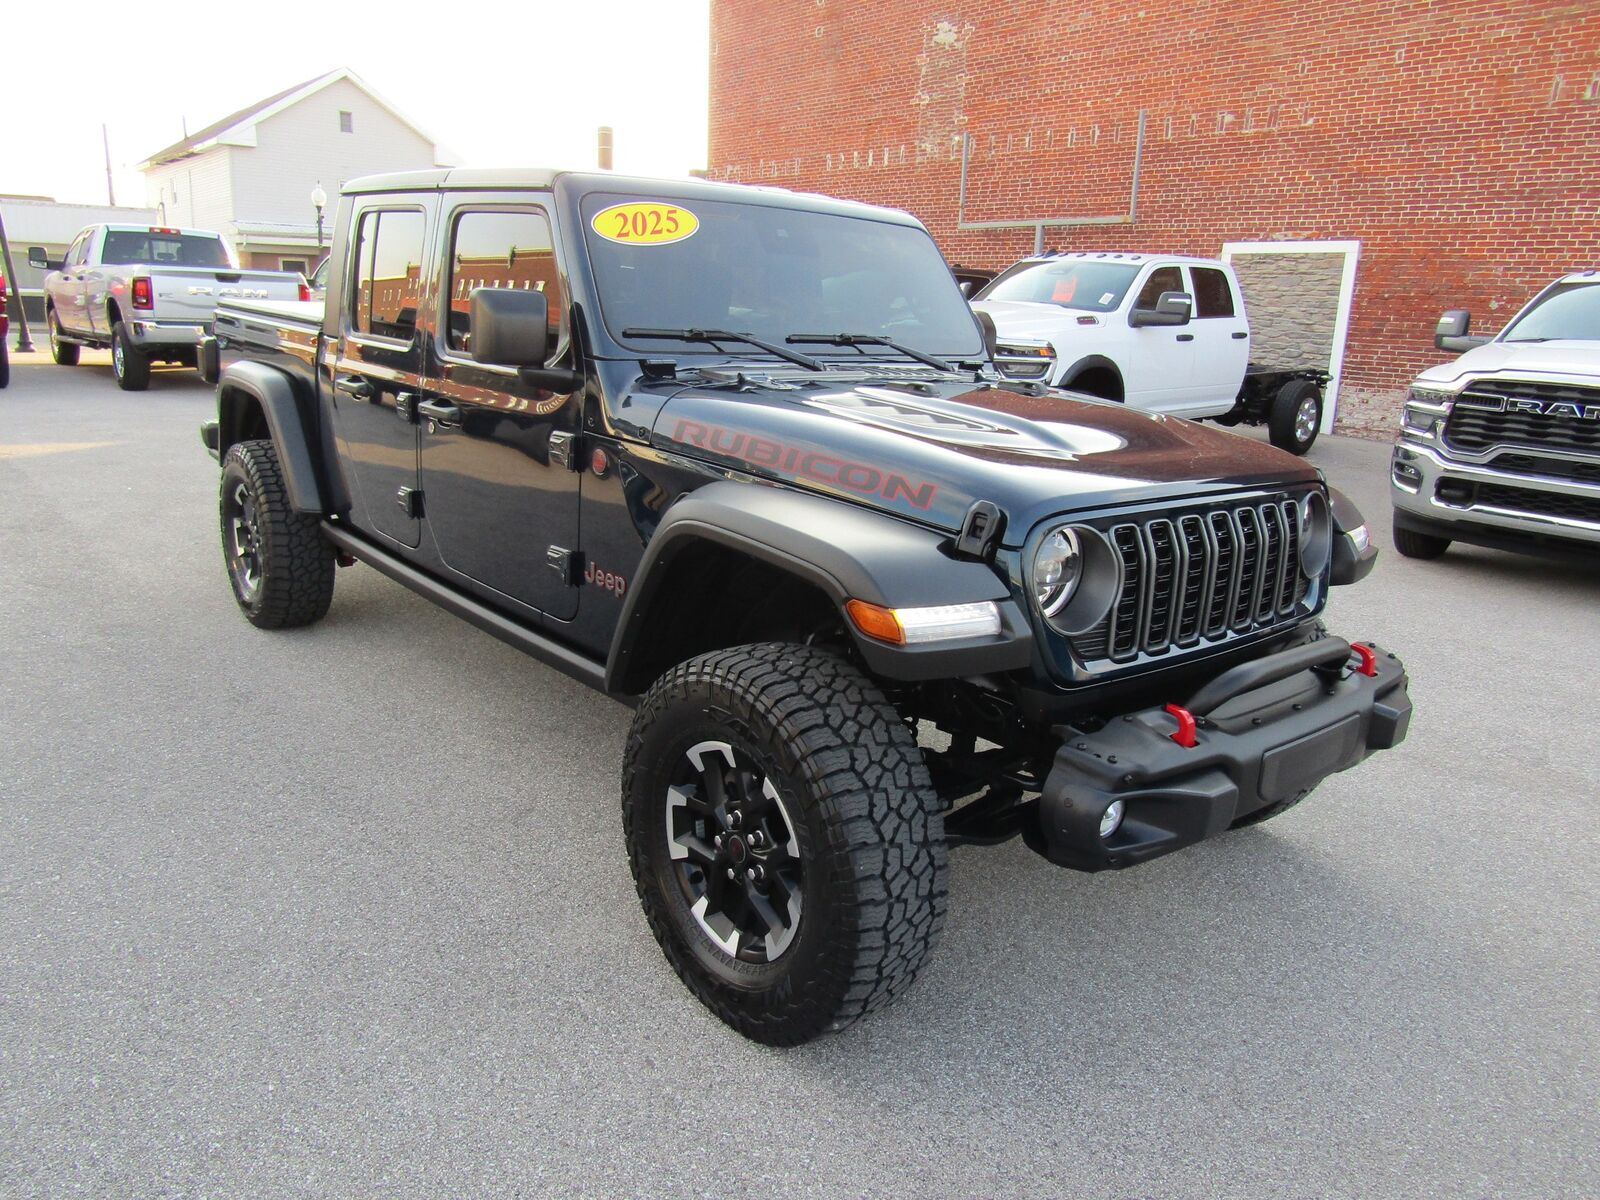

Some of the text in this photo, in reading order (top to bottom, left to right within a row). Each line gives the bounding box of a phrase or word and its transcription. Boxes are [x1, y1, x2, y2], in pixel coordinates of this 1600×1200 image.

[614, 209, 679, 238] 2025
[671, 418, 939, 511] RUBICON
[584, 560, 626, 599] Jeep
